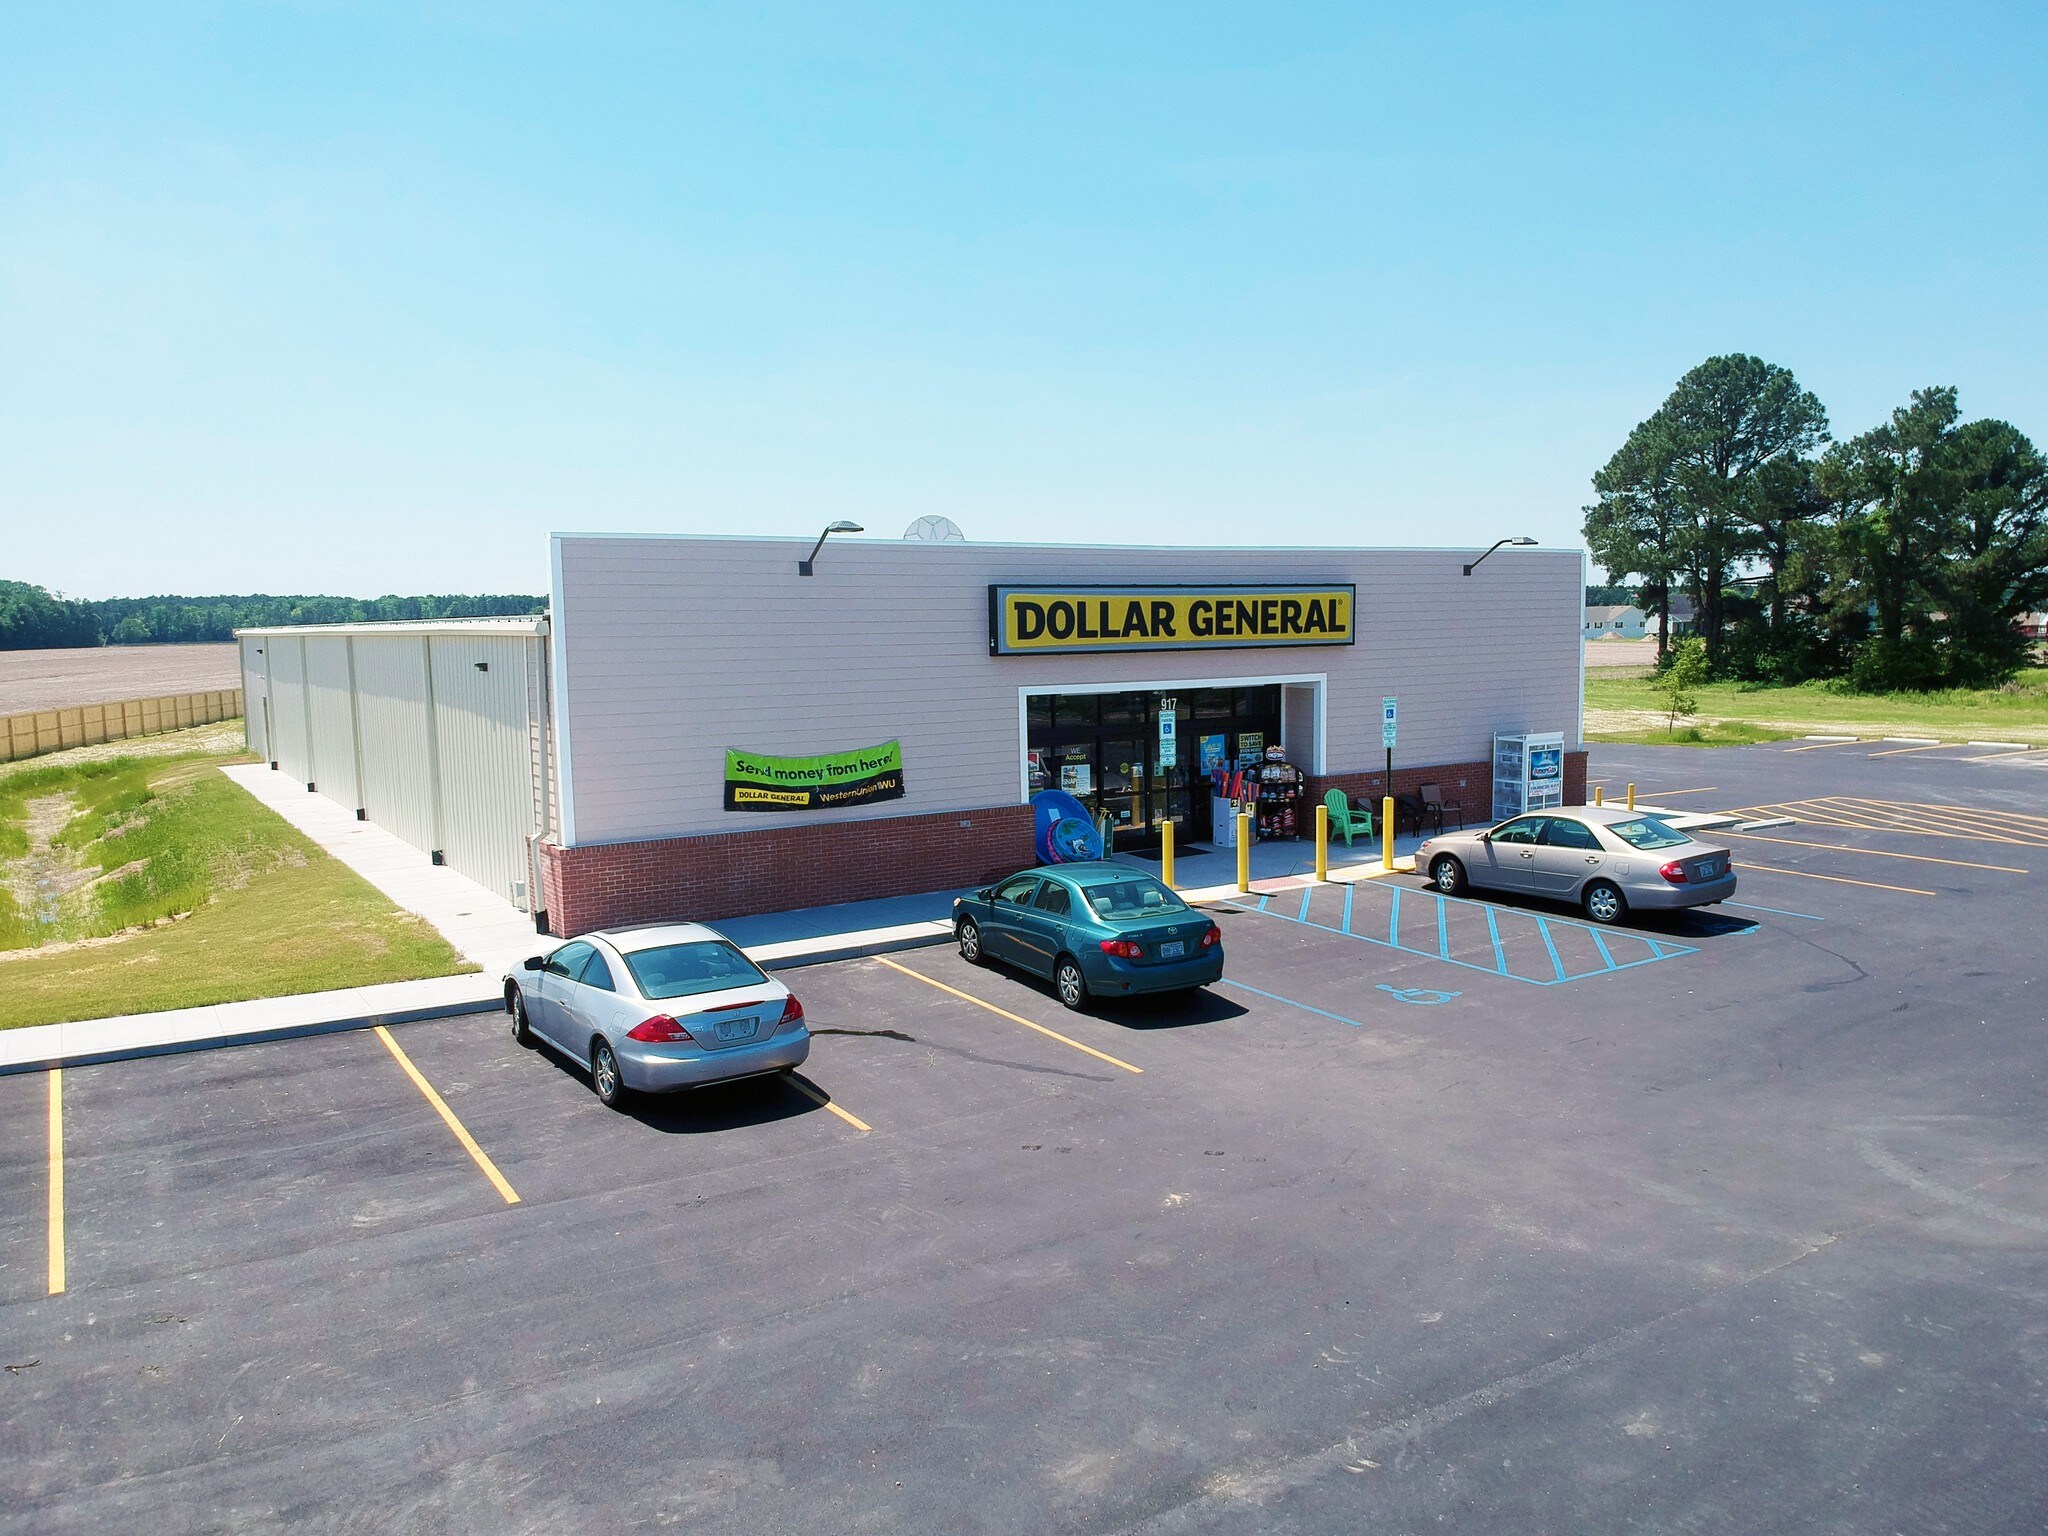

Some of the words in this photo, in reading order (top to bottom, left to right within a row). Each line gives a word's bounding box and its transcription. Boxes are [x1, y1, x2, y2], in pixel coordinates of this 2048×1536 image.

[1013, 600, 1177, 640] DOLLAR
[1188, 599, 1346, 637] GENERAL
[1161, 698, 1177, 710] 917
[1240, 734, 1262, 742] SWITCH
[736, 760, 771, 777] Send
[775, 768, 823, 781] money
[826, 763, 858, 777] from
[859, 751, 893, 771] here!
[739, 791, 769, 800] DOLLAR
[770, 793, 806, 802] GENERAL
